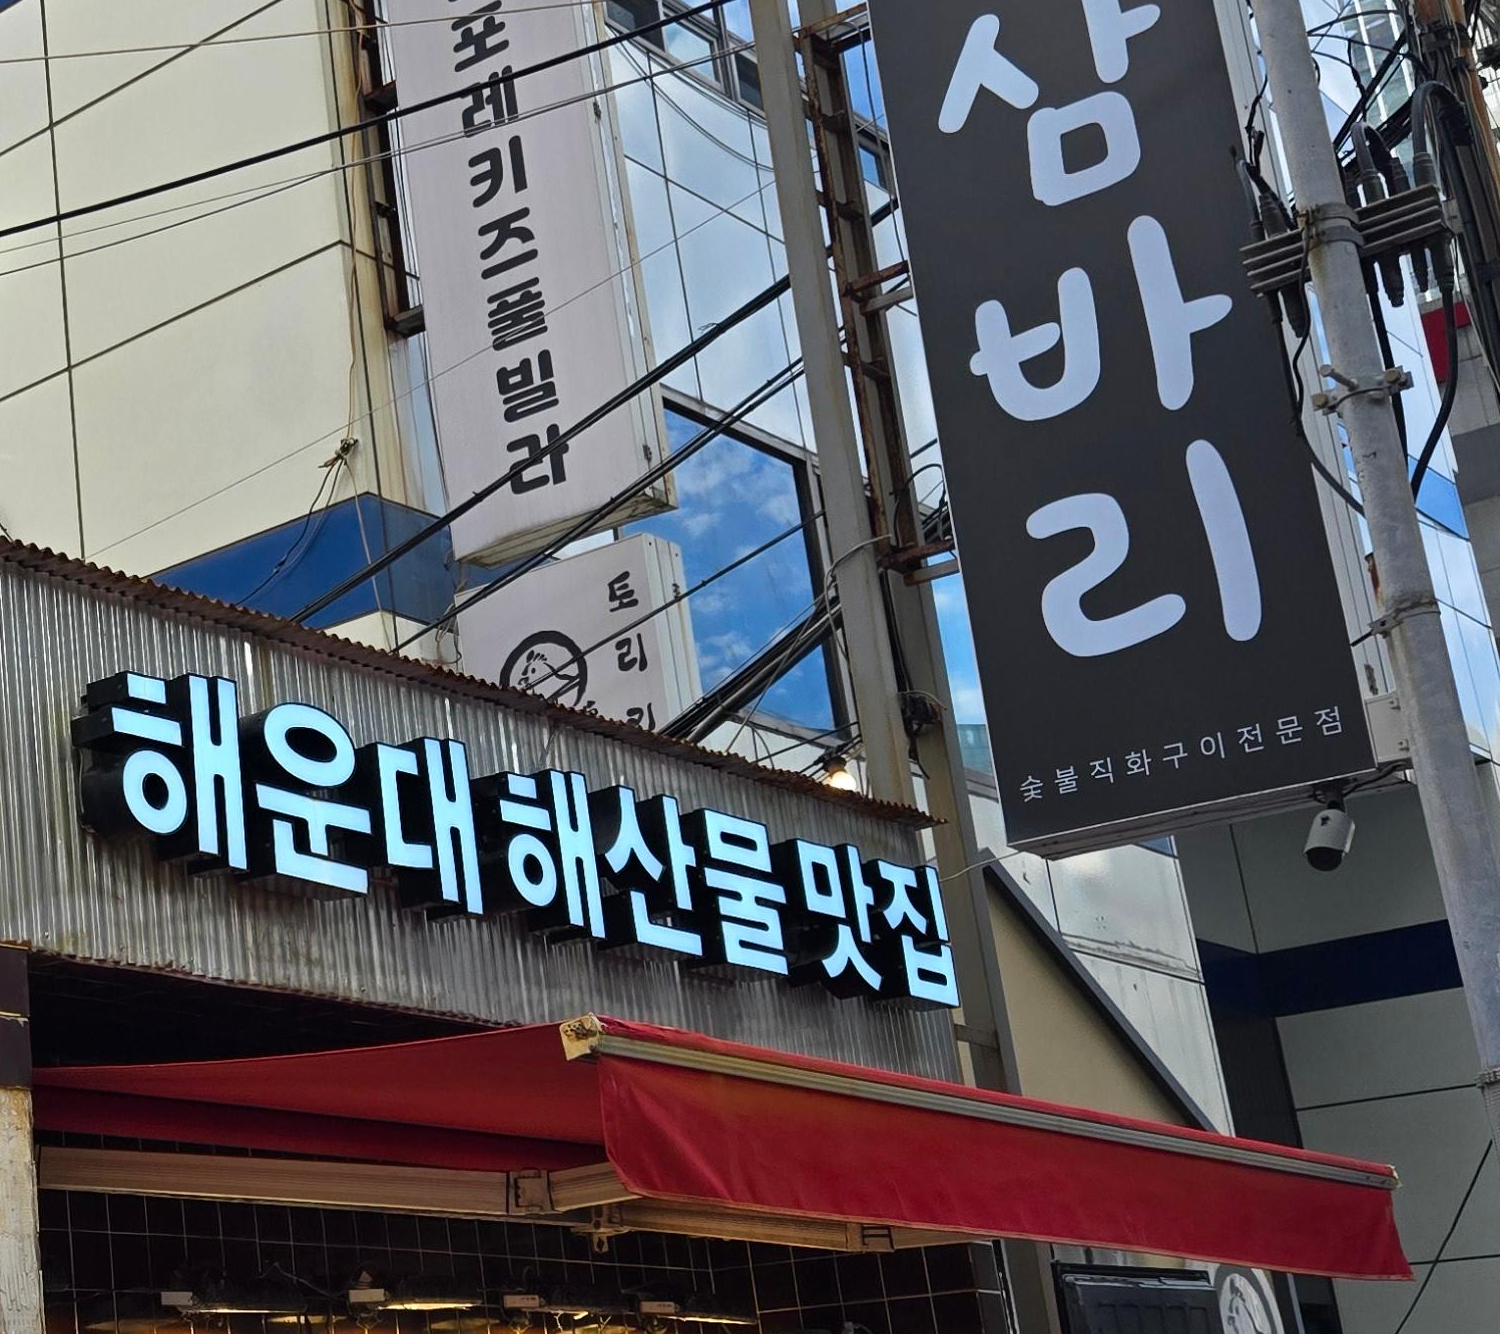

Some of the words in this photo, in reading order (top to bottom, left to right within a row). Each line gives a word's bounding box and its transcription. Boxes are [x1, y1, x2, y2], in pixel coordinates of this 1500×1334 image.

[111, 673, 483, 915] 해운대
[500, 769, 789, 976] 해산물
[797, 838, 961, 1008] 맛집
